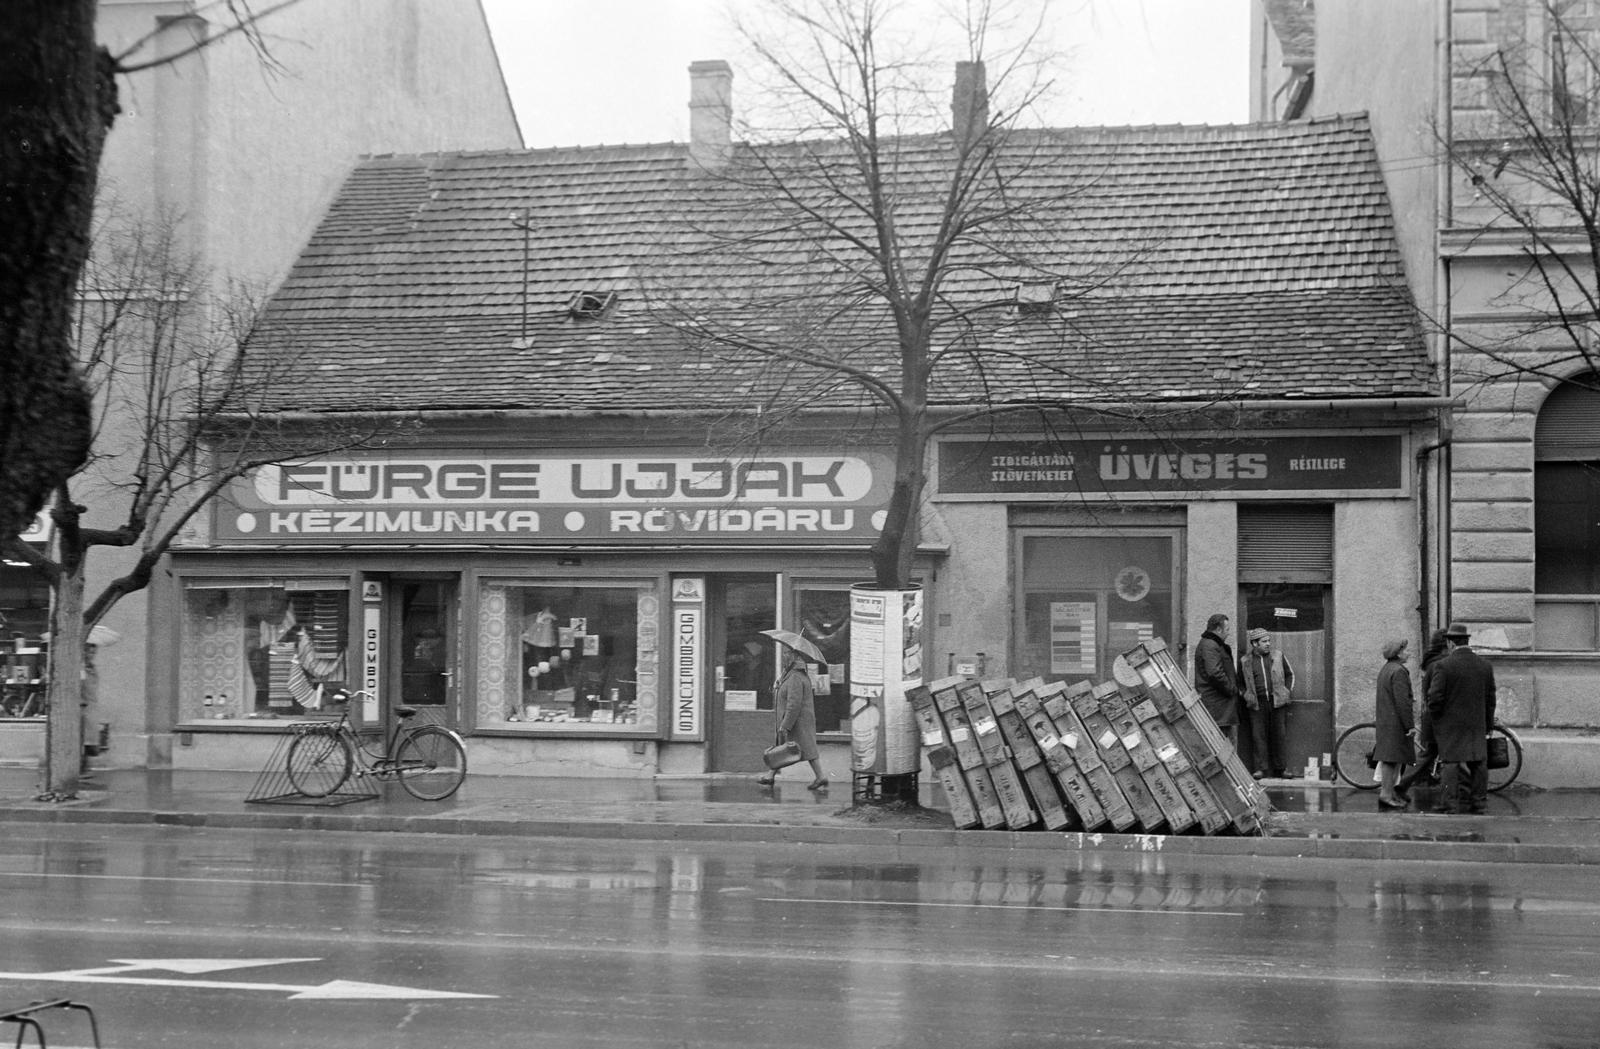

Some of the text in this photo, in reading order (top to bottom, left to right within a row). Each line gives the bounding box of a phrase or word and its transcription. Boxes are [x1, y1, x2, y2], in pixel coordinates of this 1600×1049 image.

[1099, 445, 1268, 481] ÜVEGES
[1289, 454, 1347, 471] RÉSZLEGE
[279, 460, 846, 501] FÜRGE UJJAK
[269, 508, 540, 534] KÉZIMUNKA
[609, 506, 855, 532] RÖVIDÁRU
[367, 629, 377, 701] GOMBOK
